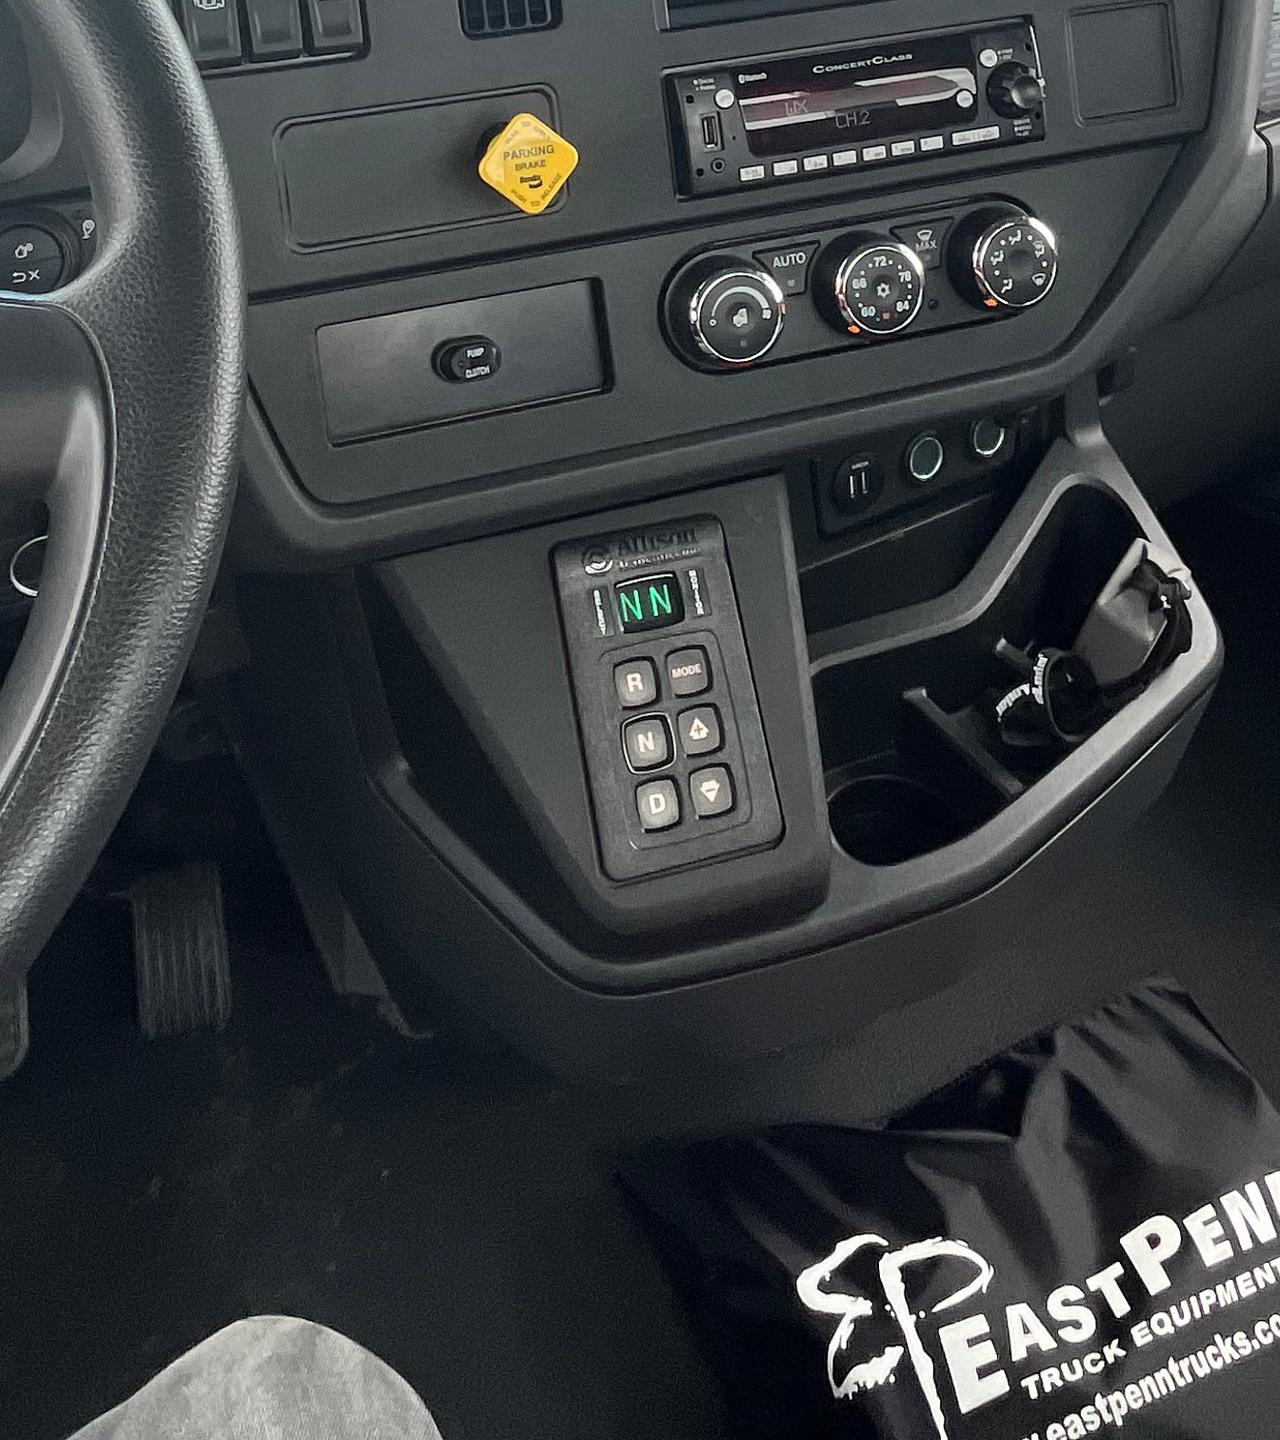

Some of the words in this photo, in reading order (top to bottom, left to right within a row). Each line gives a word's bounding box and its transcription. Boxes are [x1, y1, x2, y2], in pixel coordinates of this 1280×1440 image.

[503, 144, 555, 161] PARKING
[515, 159, 547, 172] BRAKE
[916, 238, 937, 251] MAX
[773, 252, 806, 268] AUTO
[873, 256, 888, 267] 72
[899, 271, 912, 283] 78
[861, 306, 876, 318] 60
[896, 300, 910, 312] 84
[688, 569, 705, 616] MONITOR
[593, 588, 607, 636] SELECT
[671, 662, 702, 678] MODE
[627, 672, 644, 693] R
[637, 731, 655, 753] N
[648, 793, 667, 815] D
[1020, 1338, 1127, 1400] TRUCK
